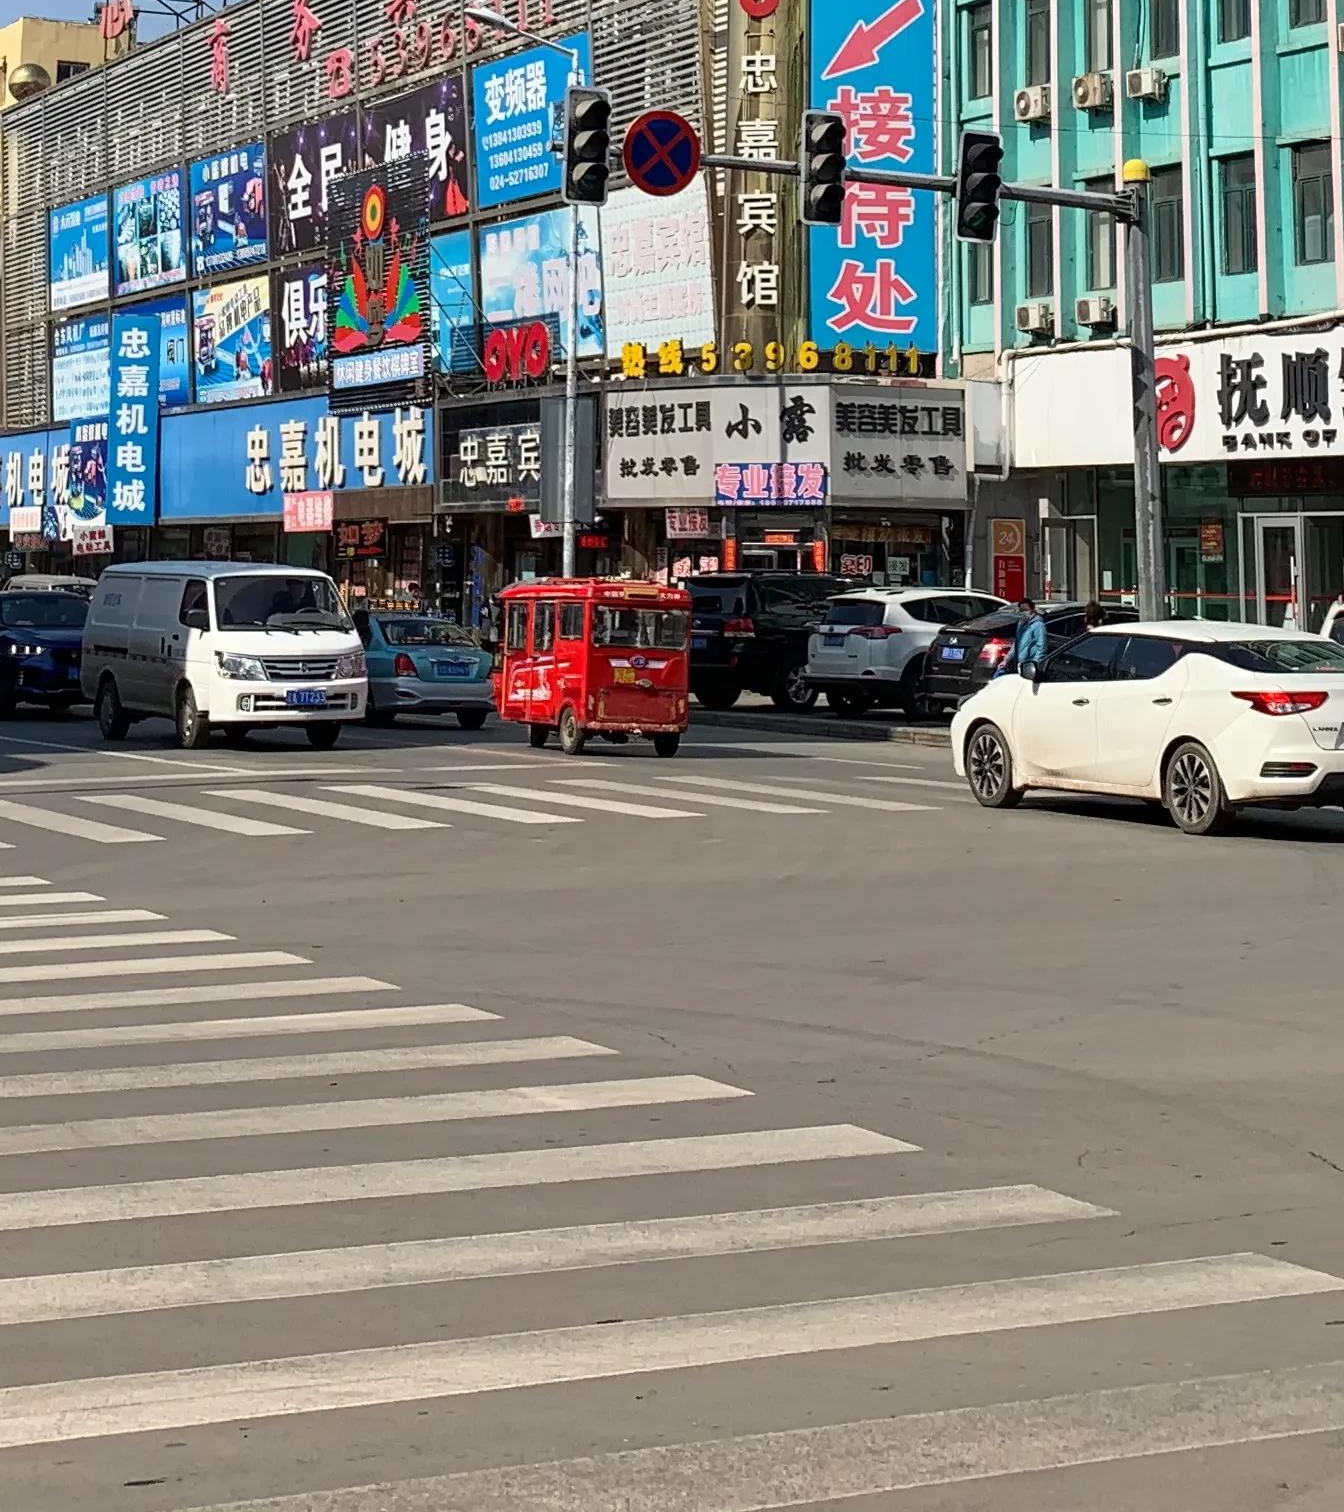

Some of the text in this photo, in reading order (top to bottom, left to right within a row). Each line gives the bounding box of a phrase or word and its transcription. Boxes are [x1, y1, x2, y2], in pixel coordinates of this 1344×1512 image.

[485, 60, 548, 125] 变频器
[736, 51, 779, 307] 忠嘉宾馆
[827, 87, 918, 334] 接待处
[484, 321, 549, 382] OYO
[621, 341, 920, 377] 热线 53968111
[112, 327, 152, 514] 忠嘉机电城
[609, 401, 712, 438] 美容美发工具
[835, 401, 963, 438] 美容美发工具
[245, 405, 429, 494] 忠嘉机电城
[1222, 431, 1294, 454] BANK
[1301, 428, 1338, 449] OF
[619, 454, 701, 479] 批发零售
[716, 463, 826, 499] 专业接发
[843, 451, 955, 478] 批发零售
